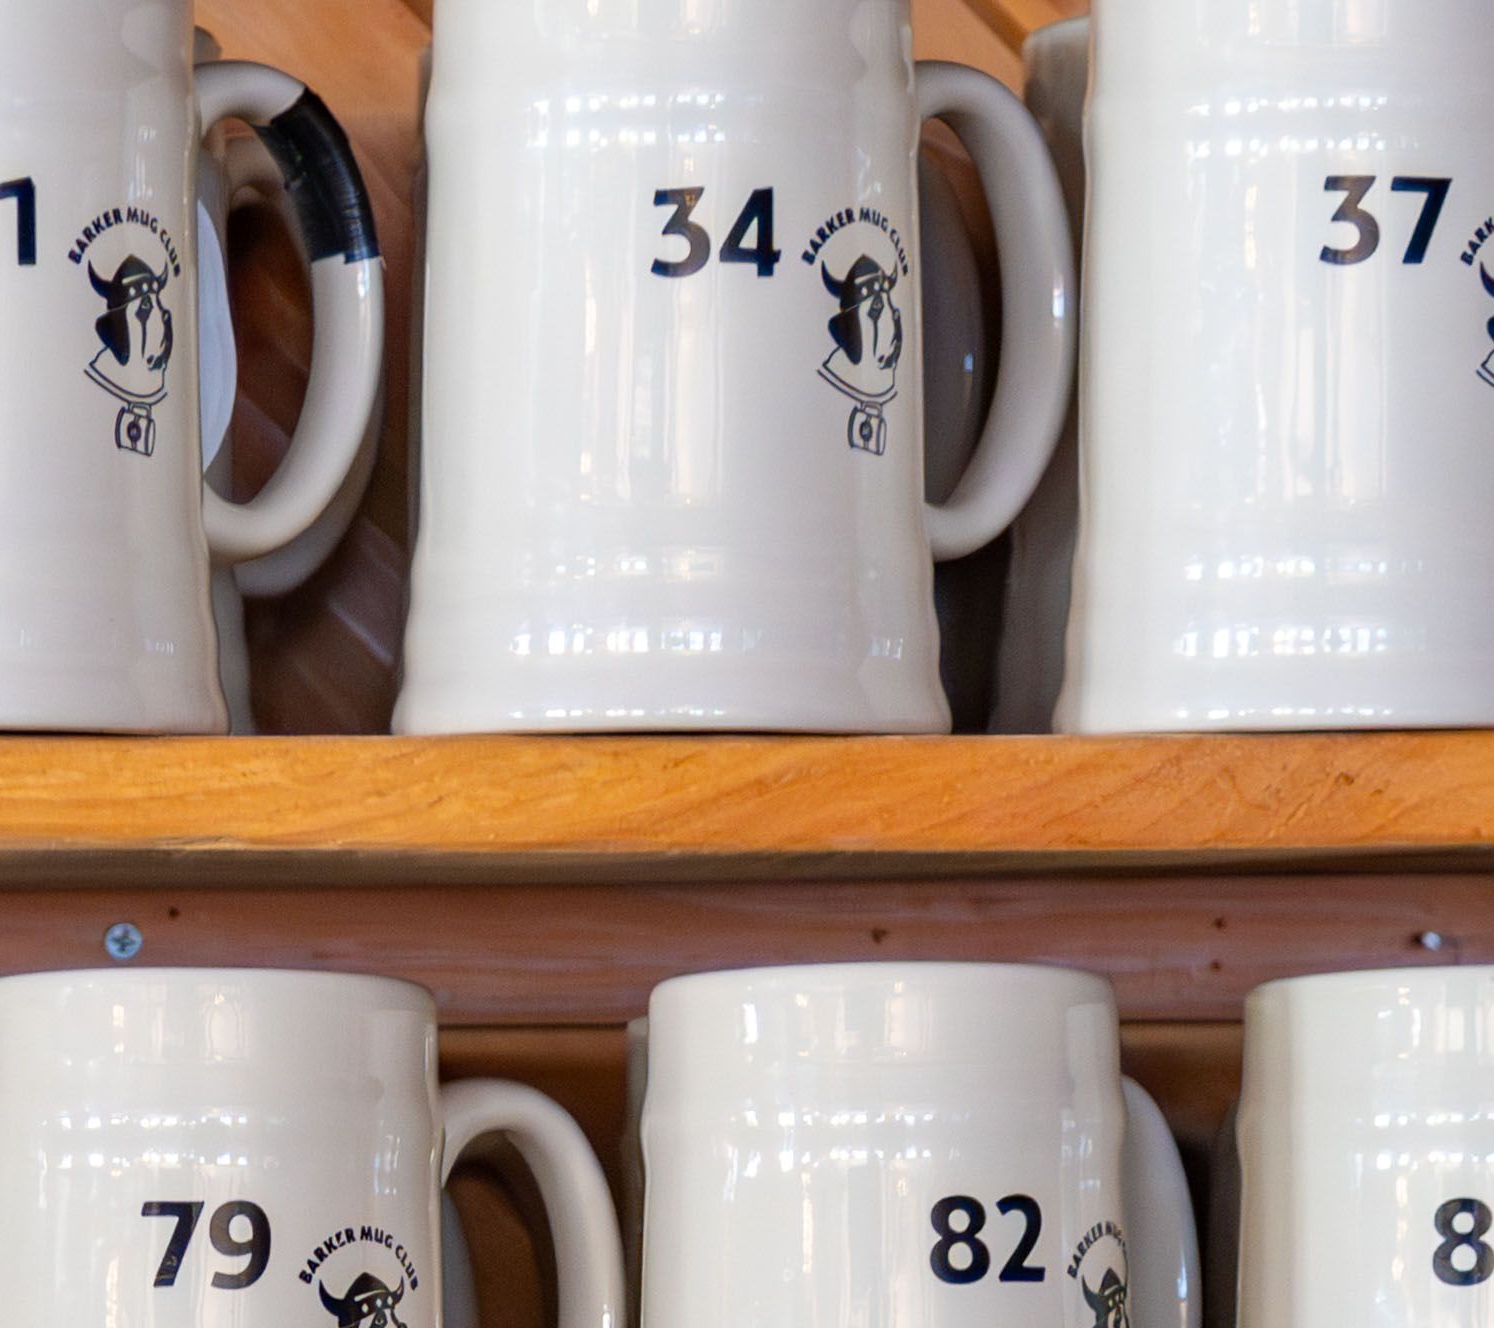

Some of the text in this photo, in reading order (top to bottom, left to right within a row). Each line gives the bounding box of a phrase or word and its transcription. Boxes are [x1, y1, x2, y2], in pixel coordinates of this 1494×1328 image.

[68, 208, 181, 275] BARKER MUG CLUB
[651, 186, 782, 277] 34
[801, 207, 909, 275] BARKER MUG CLUB
[1319, 175, 1452, 265] 37
[141, 1201, 272, 1290] 79
[299, 1225, 419, 1292] BARKER MUG CLUB
[929, 1194, 1046, 1285] 82
